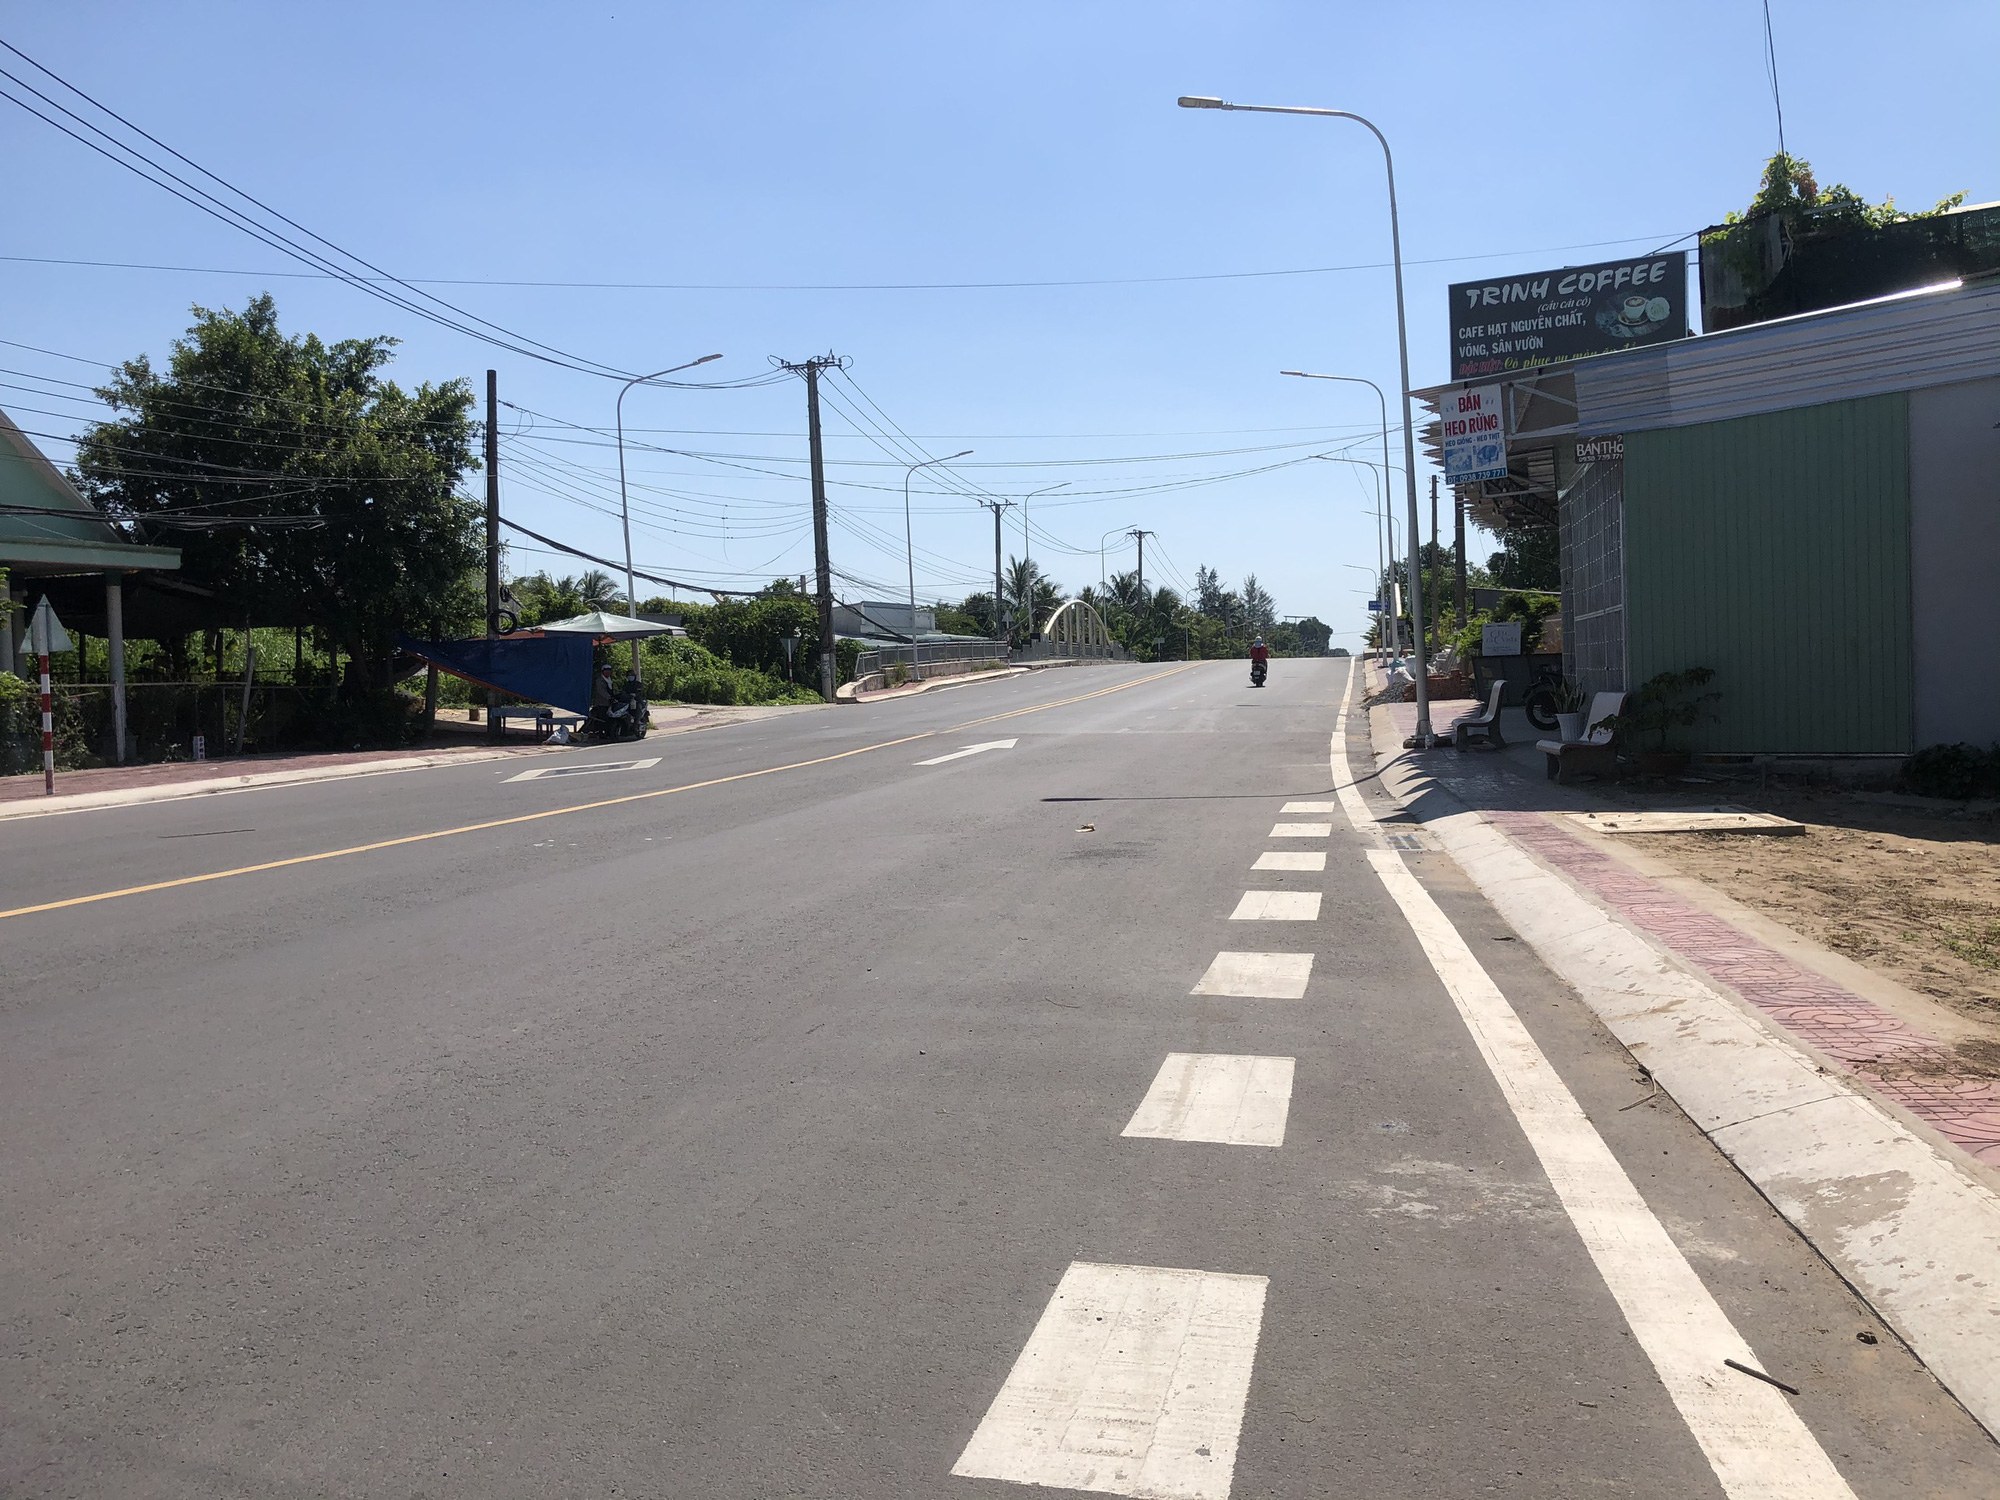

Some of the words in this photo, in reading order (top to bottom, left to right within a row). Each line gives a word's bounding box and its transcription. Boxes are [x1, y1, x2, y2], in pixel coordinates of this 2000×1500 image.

[1466, 278, 1550, 309] TRINH
[1558, 261, 1667, 295] COFFEE
[1459, 325, 1484, 339] CAFE
[1488, 322, 1507, 337] HẠT
[1511, 315, 1552, 333] NGUYÊN
[1555, 309, 1586, 327] CHẤT,
[1459, 343, 1489, 358] VÕNG,
[1492, 339, 1512, 354] SÂN
[1515, 335, 1543, 352] VƯỜN
[1458, 389, 1481, 413] BÁN
[1444, 419, 1467, 437] HEO
[1469, 412, 1498, 434] RỪNG
[1477, 434, 1488, 442] HEO
[1460, 473, 1477, 482] 0938
[1478, 471, 1491, 479] 739
[1492, 469, 1505, 477] 771
